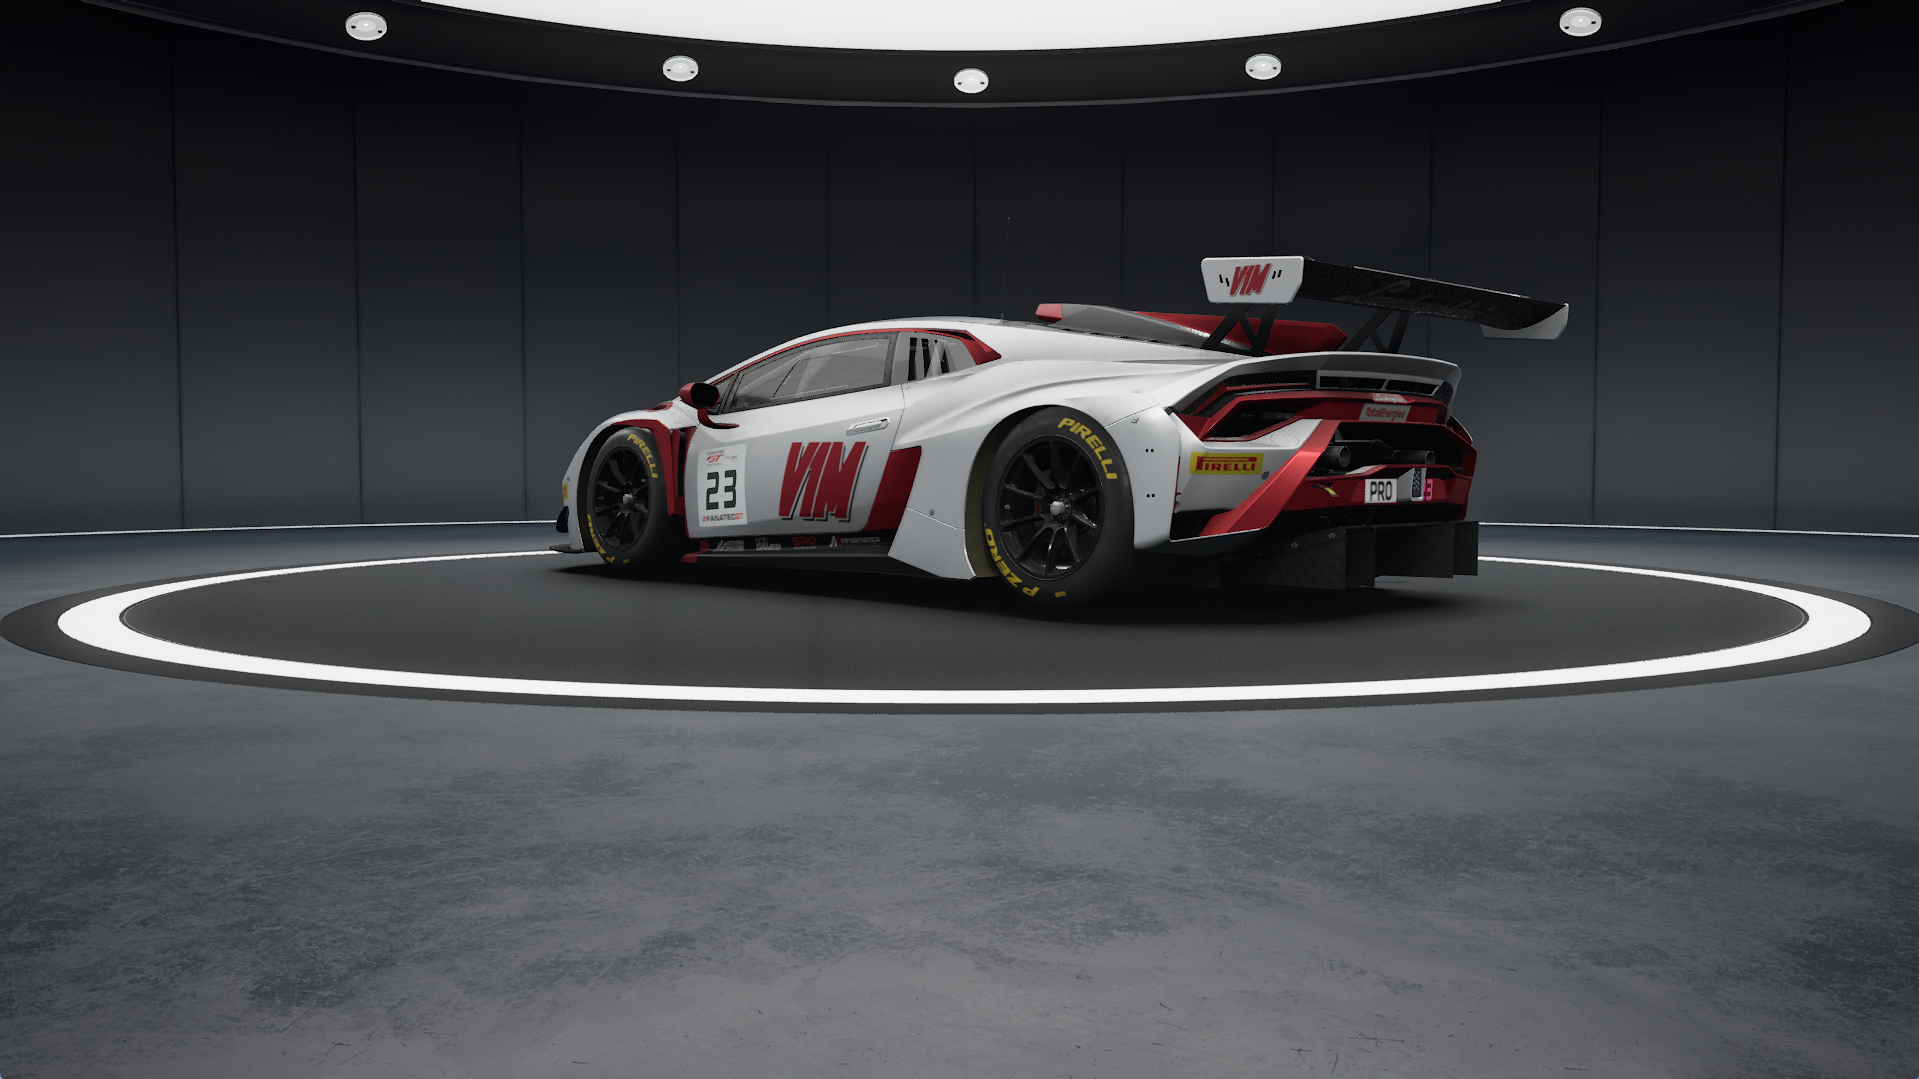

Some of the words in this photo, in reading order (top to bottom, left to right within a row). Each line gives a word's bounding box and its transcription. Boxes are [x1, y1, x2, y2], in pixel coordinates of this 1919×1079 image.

[1229, 263, 1273, 297] VIM
[1365, 406, 1407, 421] TotalEnergies
[627, 433, 659, 479] PIRELLI
[1057, 417, 1118, 480] PIRELLI
[1196, 455, 1257, 472] PIRELLI
[706, 469, 737, 510] 23
[778, 441, 870, 523] VIM
[1370, 480, 1393, 502] PRO
[792, 536, 817, 546] SRO
[984, 526, 1023, 588] ZERO
[1022, 586, 1040, 597] P
